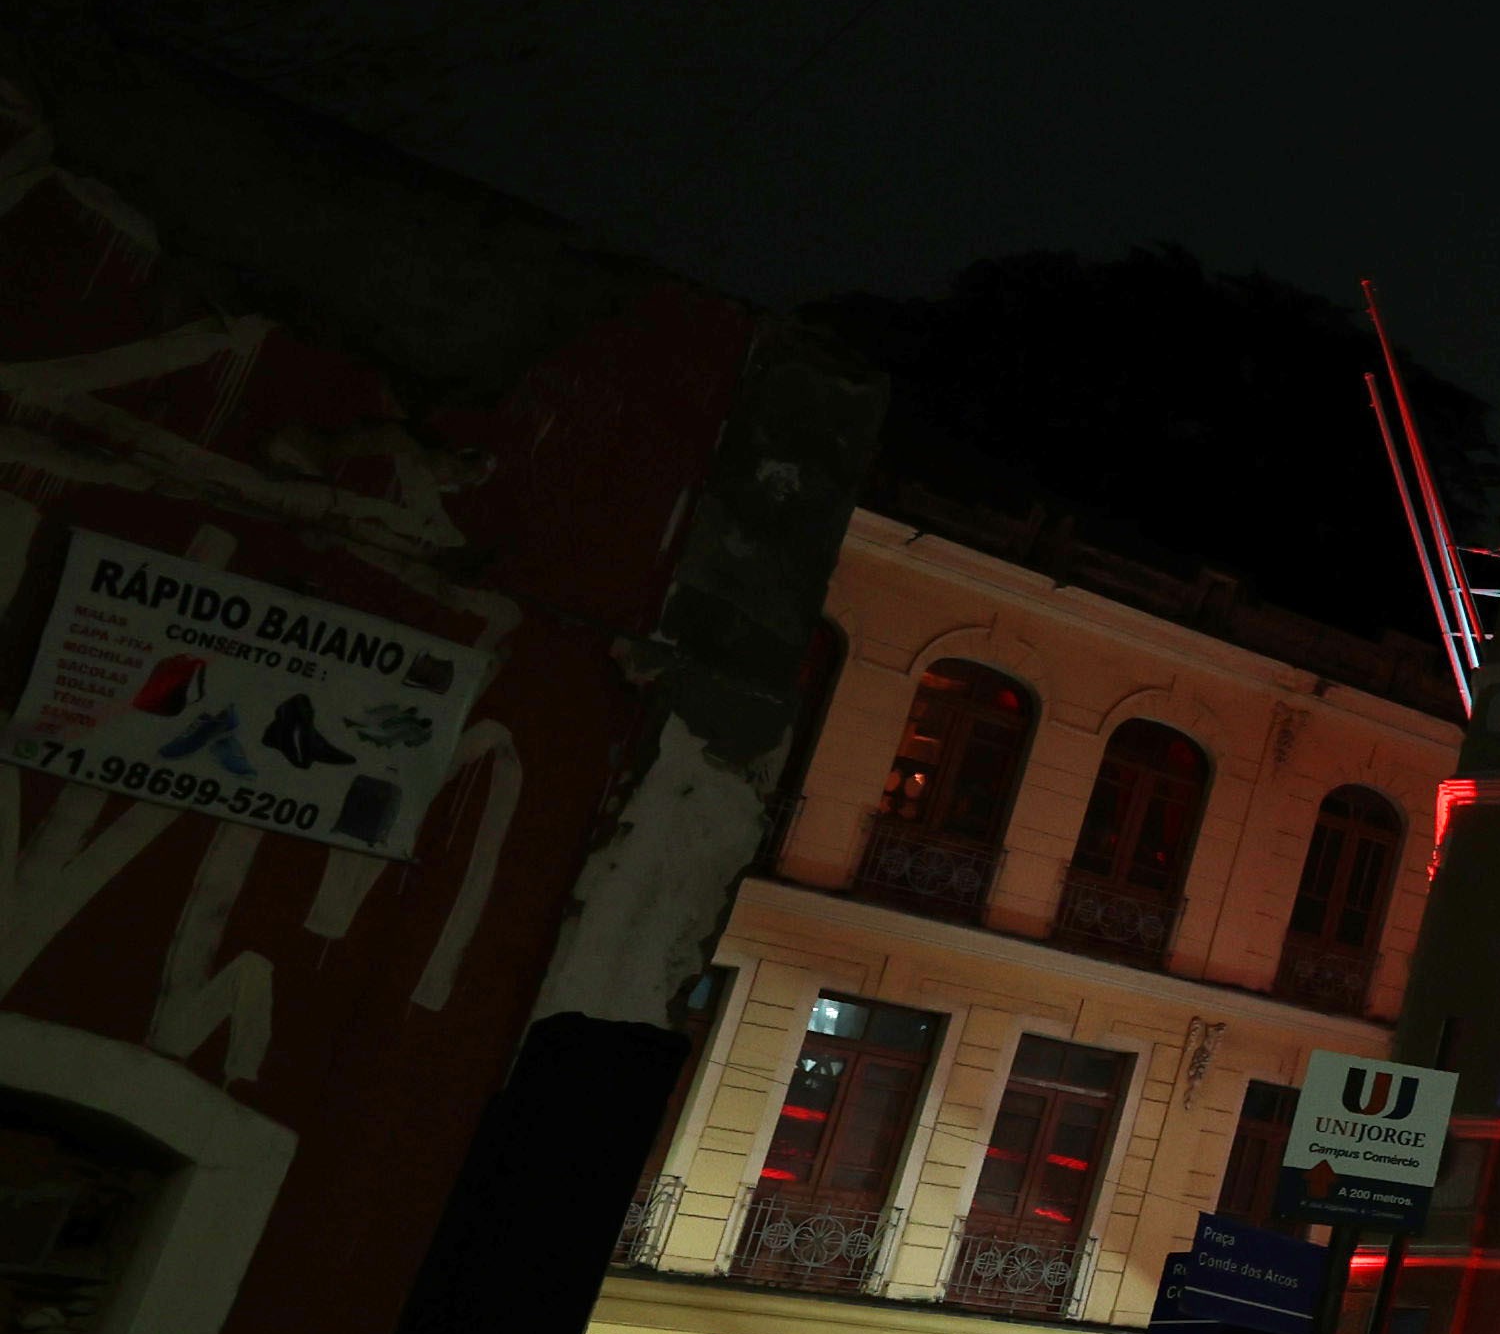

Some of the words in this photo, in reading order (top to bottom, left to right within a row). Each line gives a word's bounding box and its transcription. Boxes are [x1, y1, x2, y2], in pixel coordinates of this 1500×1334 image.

[90, 559, 251, 631] RÁPIDO
[256, 607, 405, 675] BAIANO
[166, 623, 282, 668] CONSERTO
[286, 656, 315, 679] DE
[40, 741, 320, 831] 71.98699-5200
[1315, 1117, 1427, 1148] UNIJORGE
[1308, 1142, 1360, 1160] Campus
[1362, 1150, 1420, 1168] Comércio
[1338, 1186, 1347, 1196] A
[1202, 1226, 1236, 1250] Praça
[1199, 1252, 1239, 1274] Conde
[1241, 1261, 1262, 1279] dos
[1264, 1268, 1300, 1290] Arcos
